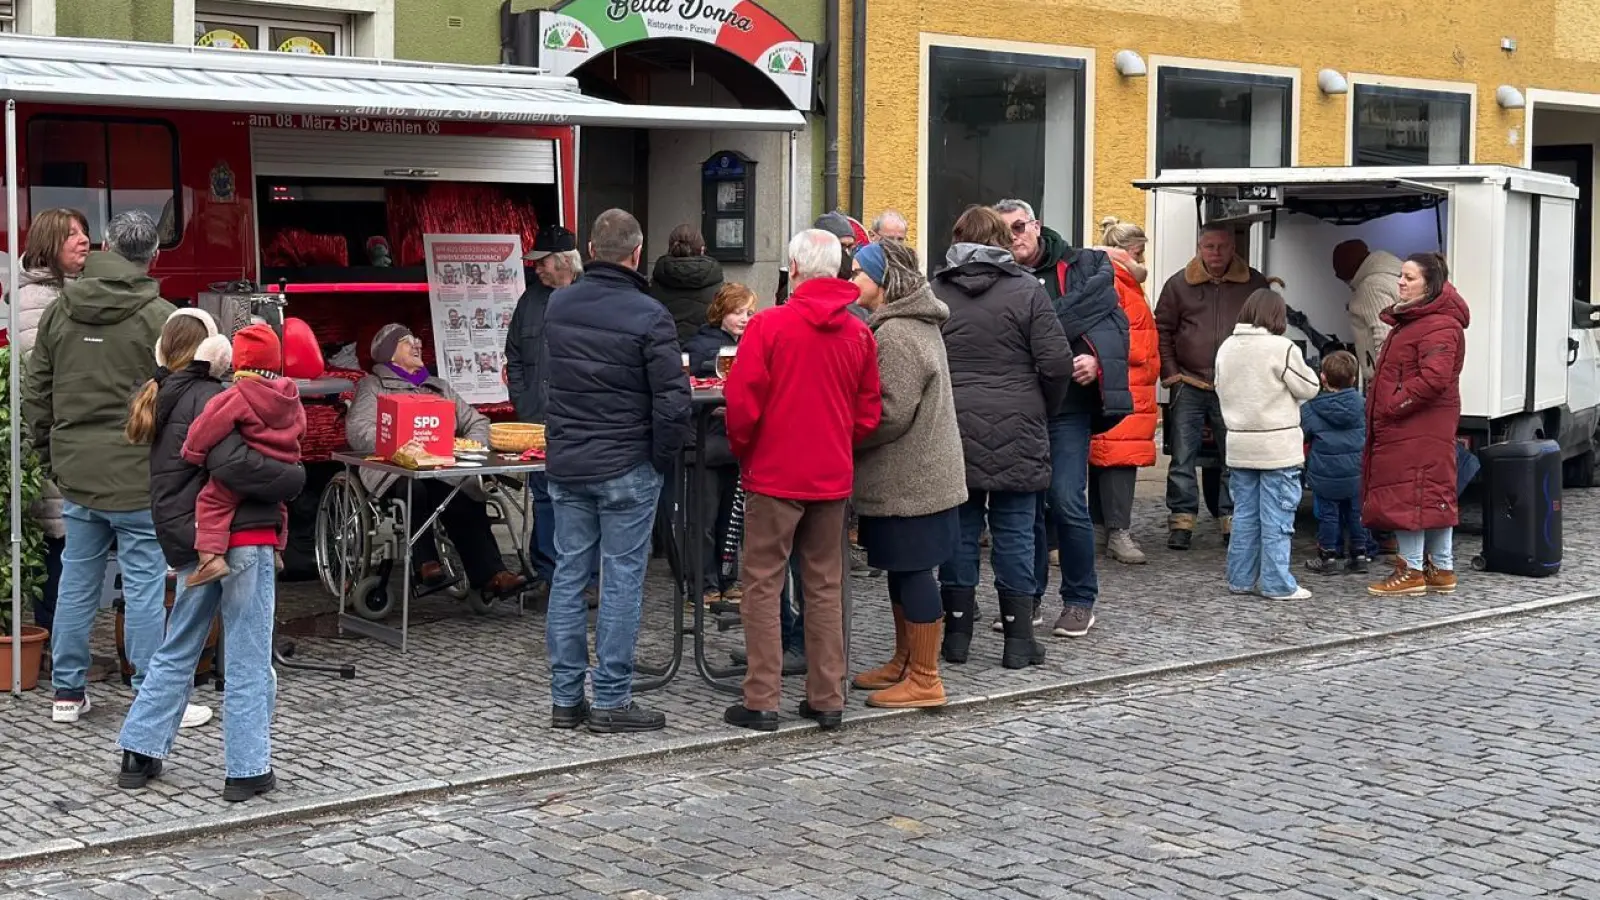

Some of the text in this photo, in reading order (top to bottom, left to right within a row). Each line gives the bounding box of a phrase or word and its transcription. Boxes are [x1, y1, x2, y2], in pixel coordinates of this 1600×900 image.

[607, 0, 753, 31] Bella Donna
[647, 19, 684, 32] Ristorante
[689, 23, 717, 35] Pizzeria
[249, 113, 272, 127] am
[275, 113, 298, 129] 08.
[301, 114, 337, 131] März
[339, 115, 370, 132] SPD
[372, 118, 421, 133] wählen
[413, 415, 440, 429] SPD
